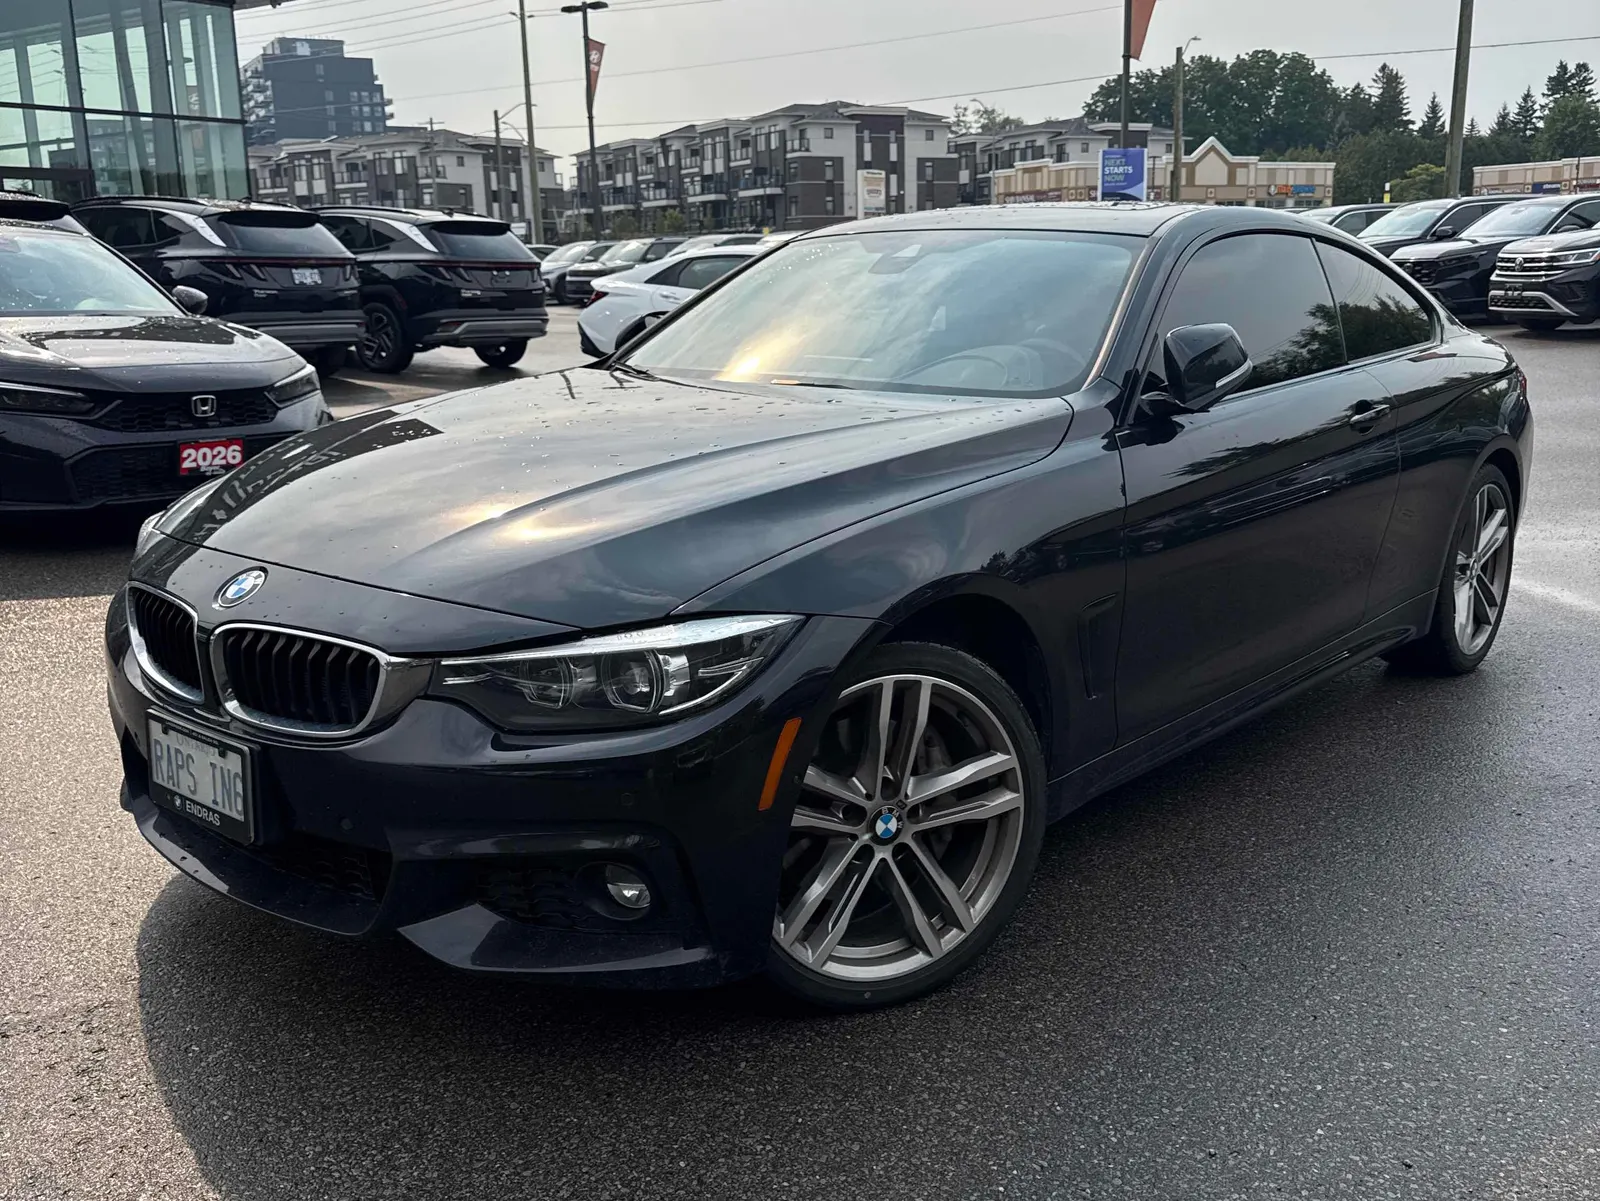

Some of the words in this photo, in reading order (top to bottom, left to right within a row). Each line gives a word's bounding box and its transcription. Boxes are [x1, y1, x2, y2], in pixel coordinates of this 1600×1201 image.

[1104, 165, 1133, 174] STARTS
[181, 445, 242, 468] 2026
[153, 738, 198, 796] RAPS
[186, 801, 221, 826] ENDRAS
[881, 807, 904, 829] BMW
